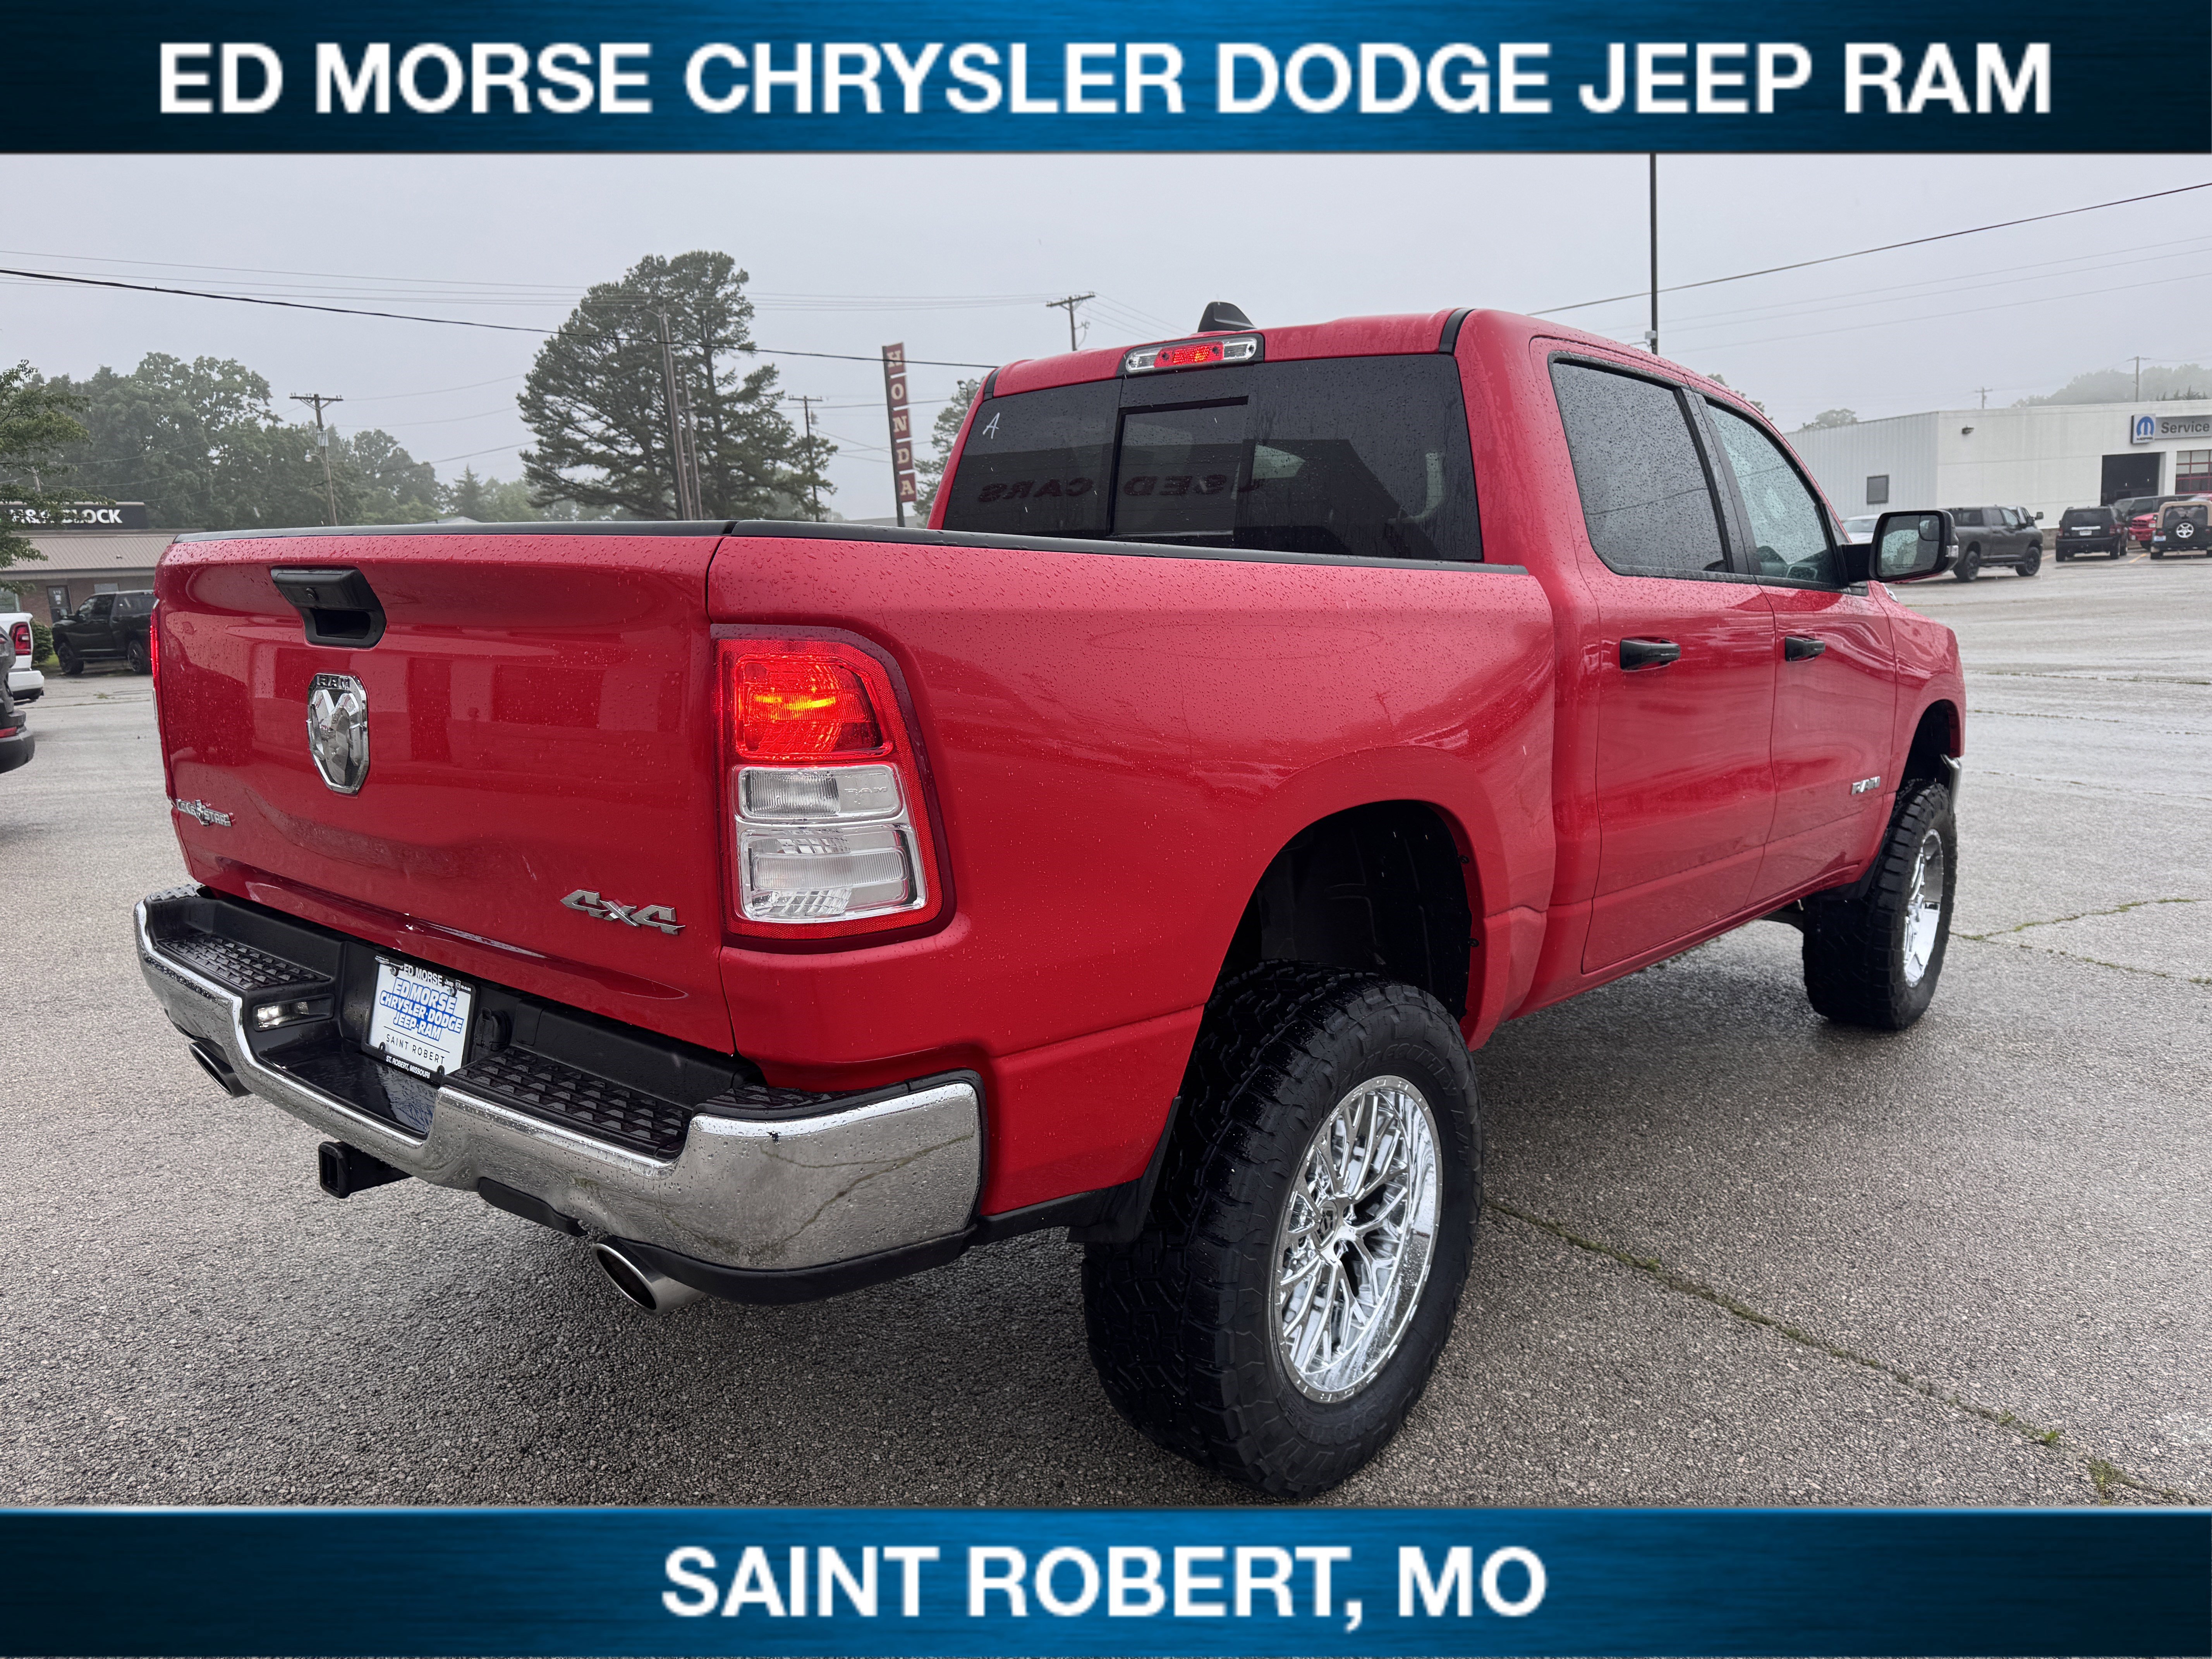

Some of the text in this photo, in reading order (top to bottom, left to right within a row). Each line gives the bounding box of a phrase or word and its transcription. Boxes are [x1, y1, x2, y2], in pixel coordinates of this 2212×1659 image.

[887, 350, 914, 496] HONDA
[982, 412, 1000, 439] A
[2161, 421, 2210, 433] Service
[404, 963, 414, 976] ED
[416, 967, 443, 986] MORSE
[393, 977, 457, 1015] ED MORSE
[386, 1034, 445, 1065] SAINT ROBERT
[409, 1065, 431, 1079] MISSOURI
